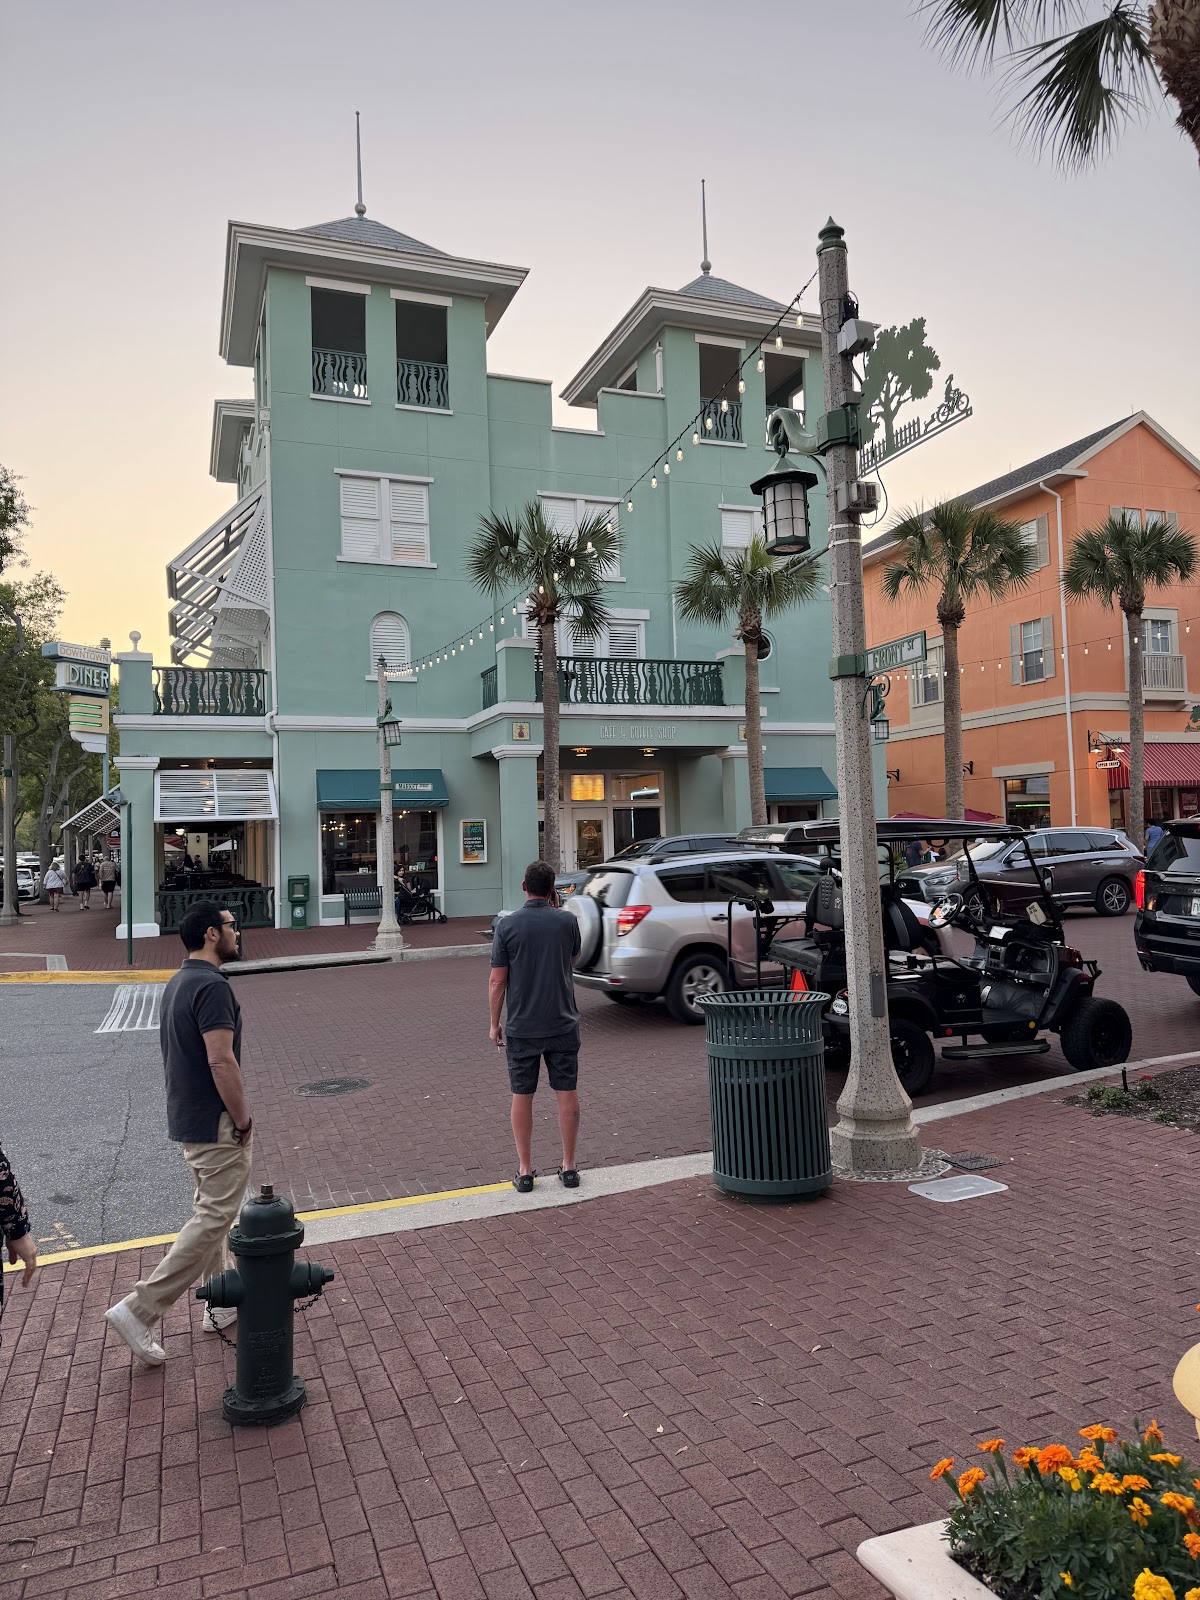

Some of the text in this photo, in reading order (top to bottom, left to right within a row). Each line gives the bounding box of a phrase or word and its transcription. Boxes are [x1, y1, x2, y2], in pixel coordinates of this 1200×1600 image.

[60, 647, 109, 662] DOWNTOWN
[873, 639, 915, 669] FRONT ST
[69, 664, 109, 688] DINER
[600, 725, 616, 740] CAFE
[630, 725, 654, 740] COFFEE
[658, 726, 676, 740] SHOP
